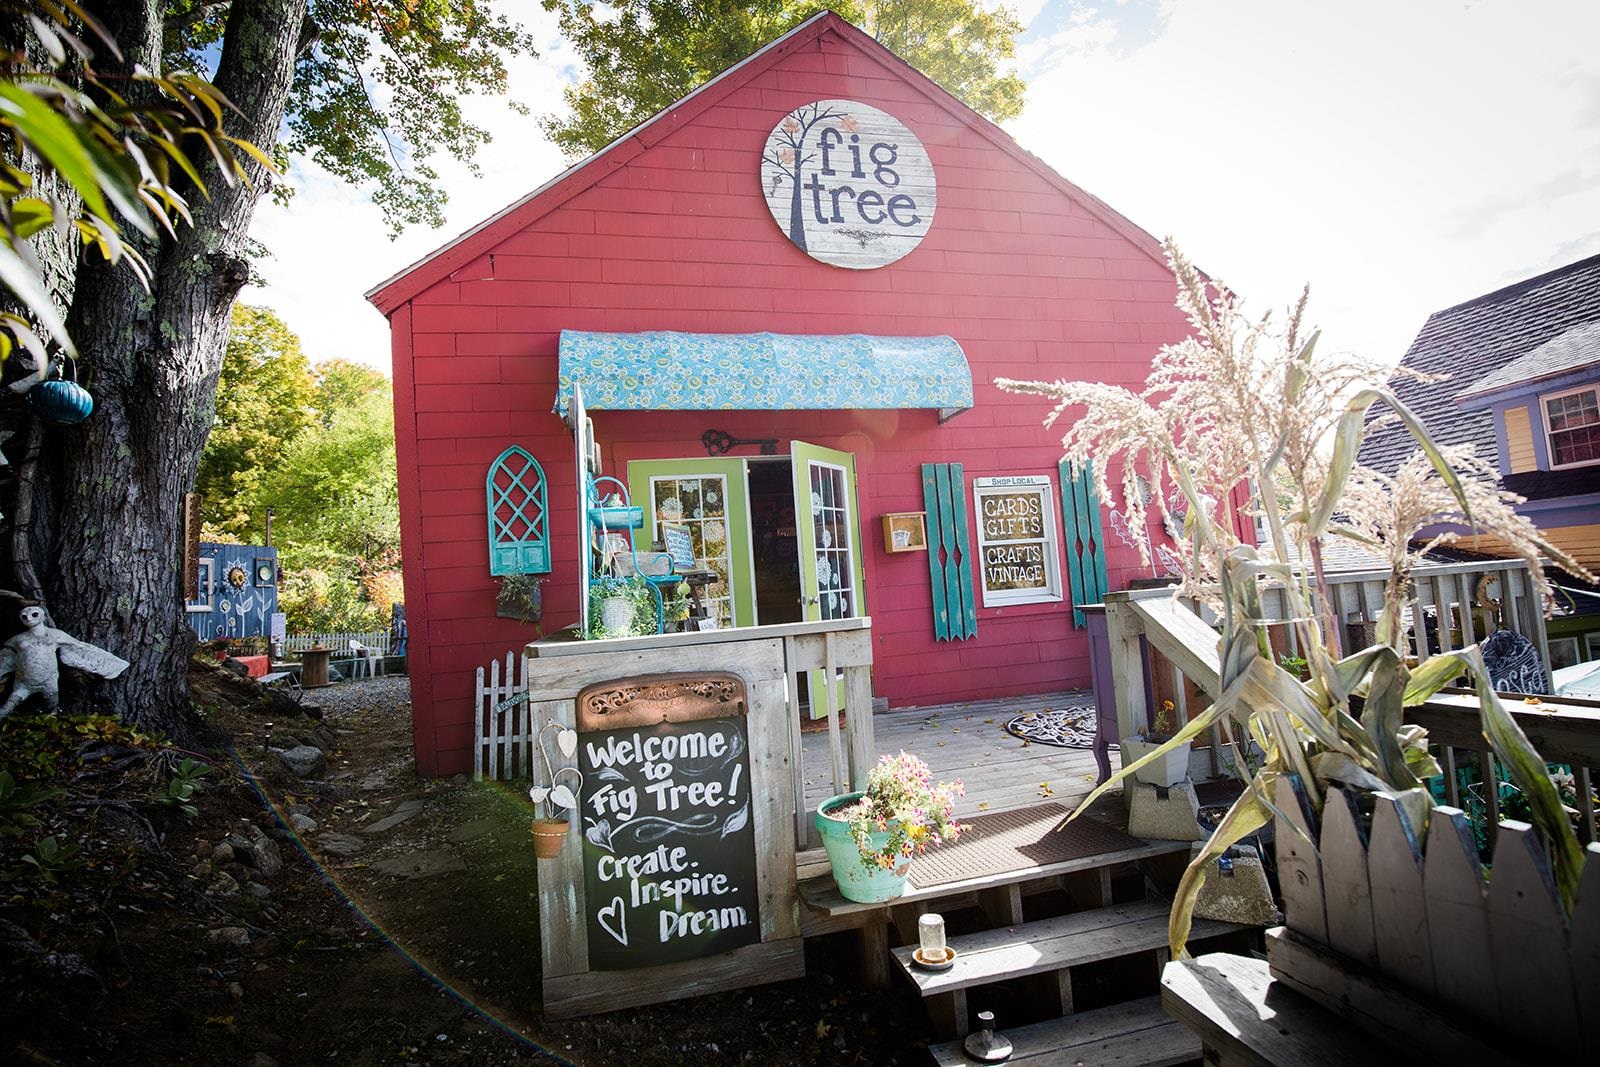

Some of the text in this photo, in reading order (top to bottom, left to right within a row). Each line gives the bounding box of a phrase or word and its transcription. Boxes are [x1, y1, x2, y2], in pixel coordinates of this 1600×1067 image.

[816, 127, 900, 188] fig
[804, 173, 922, 227] tree
[992, 477, 1036, 486] SHOP LOCAL
[985, 498, 1039, 516] CARDS
[987, 517, 1040, 536] GIFTS
[987, 546, 1041, 564] CRAFTS
[988, 565, 1042, 583] VINTAGE
[586, 732, 728, 769] Welcome
[639, 761, 673, 781] to
[588, 784, 638, 821] Fig
[631, 873, 738, 913] Inspire.
